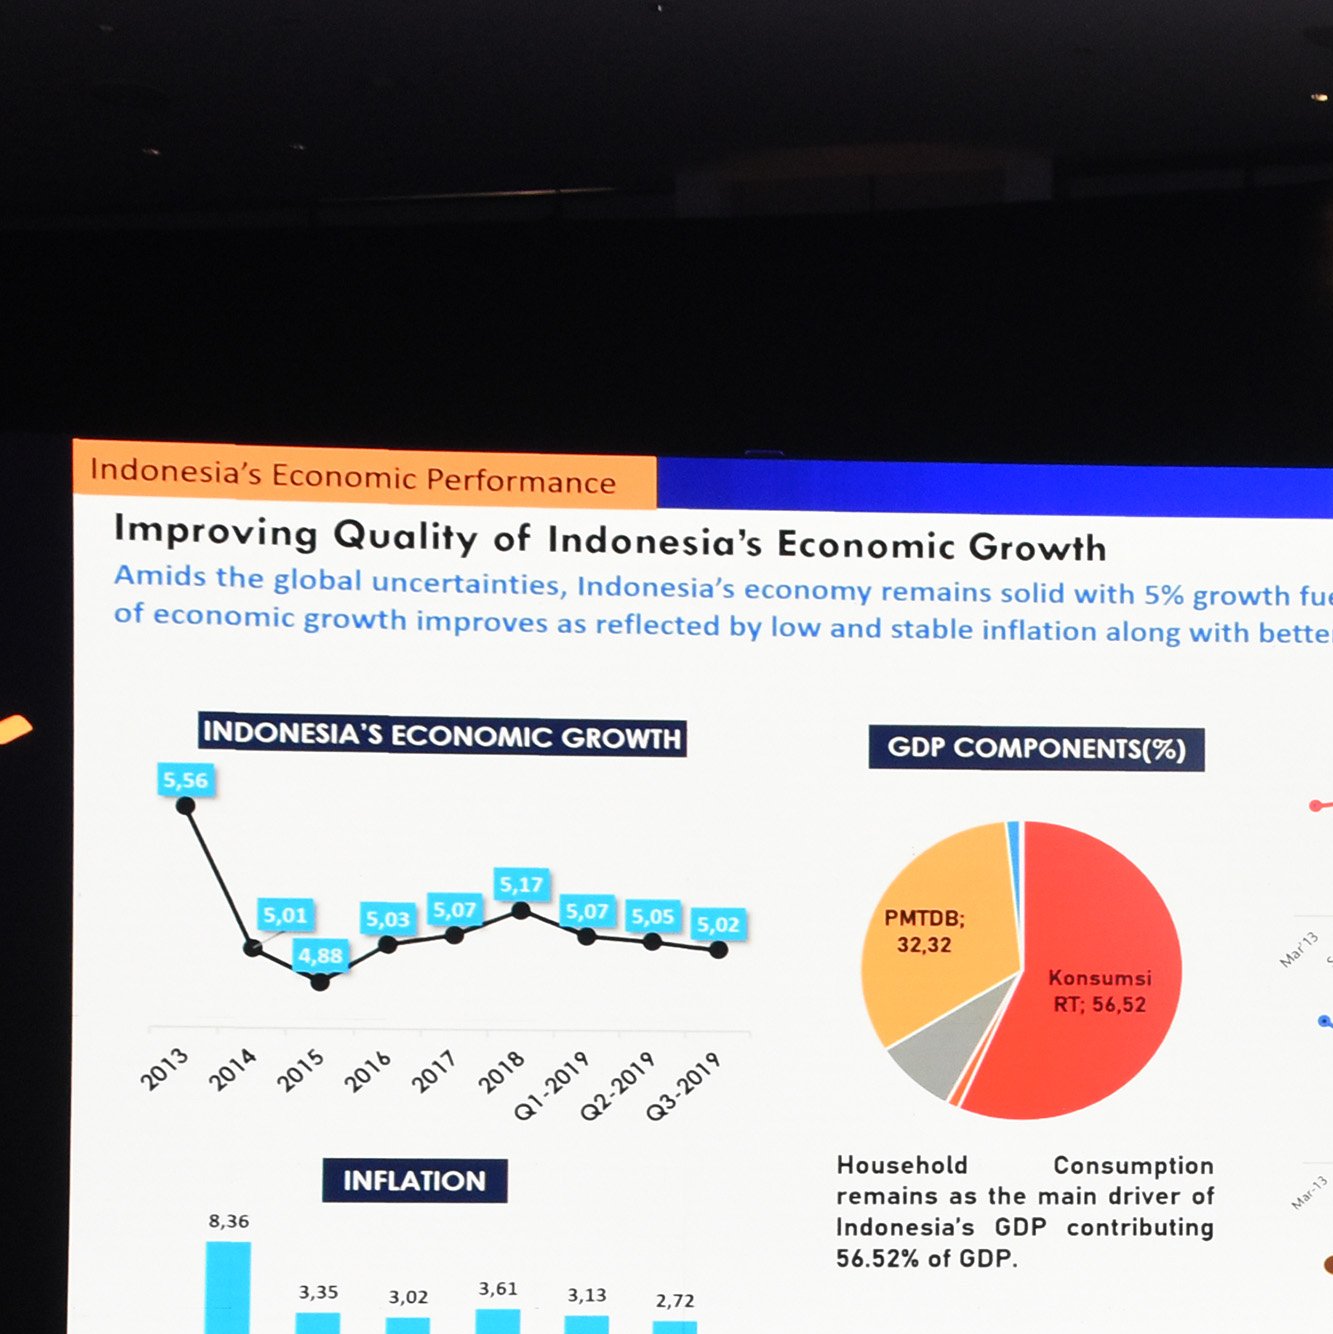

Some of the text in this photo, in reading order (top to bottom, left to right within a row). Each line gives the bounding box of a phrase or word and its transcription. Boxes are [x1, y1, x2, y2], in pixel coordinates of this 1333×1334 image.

[91, 456, 617, 495] Indonesia's Economic Performance
[115, 512, 1106, 562] Improving Quality of Indonesia's Economic Growth
[113, 564, 207, 587] Amids
[215, 565, 264, 589] the
[273, 567, 362, 595] global
[372, 573, 567, 600] uncertainties,
[578, 574, 735, 599] Indonesia's
[744, 583, 872, 606] economy
[882, 581, 992, 603] remains
[1001, 581, 1065, 604] solid
[1073, 582, 1135, 605] with
[1145, 584, 1185, 606] 5%
[1192, 584, 1291, 611] growth
[114, 601, 145, 624] of
[153, 606, 295, 628] economic
[303, 608, 407, 634] growth
[417, 609, 548, 637] improves
[557, 618, 587, 634] as
[596, 612, 720, 637] reflected
[730, 614, 763, 642] by
[771, 615, 822, 638] low
[830, 616, 882, 639] and
[891, 617, 974, 640] stable
[983, 618, 1097, 642] inflation
[1106, 620, 1181, 648] along
[1189, 621, 1250, 643] with
[203, 720, 681, 750] INDONESIA'S ECONOMIC GROWTH
[887, 736, 1187, 765] GDP COMPONENTS(%)
[163, 771, 209, 792] 5,56
[500, 876, 544, 896] 5,17
[263, 906, 307, 926] 5,01
[367, 911, 411, 930] 5,03
[433, 901, 477, 921] 5,07
[566, 903, 609, 923] 5,07
[632, 908, 675, 928] 5,05
[885, 909, 965, 929] PMTDB;
[697, 916, 740, 936] 5,02
[897, 936, 952, 956] 32,32
[297, 947, 344, 967] 4,88
[1048, 969, 1152, 987] Konsumsi
[1054, 995, 1146, 1015] RT; 56,52
[139, 1047, 189, 1092] 2013
[477, 1051, 525, 1095] 2018
[512, 1050, 591, 1123] Q1-2019
[578, 1050, 657, 1123] Q2-2019
[644, 1050, 721, 1123] Q3-2019
[837, 1154, 1214, 1181] Household Consumption
[344, 1170, 486, 1192] INFLATION
[837, 1185, 1215, 1206] remains as the main driver of
[208, 1213, 250, 1231] 8,36
[836, 1216, 1214, 1242] Indonesia's GDP contributing
[836, 1248, 1018, 1268] 56.52% of GDP.
[299, 1284, 339, 1302] 3,35
[388, 1289, 429, 1307] 3,02
[478, 1281, 518, 1298] 3,61
[567, 1287, 607, 1305] 3,13
[656, 1293, 695, 1311] 2,72
